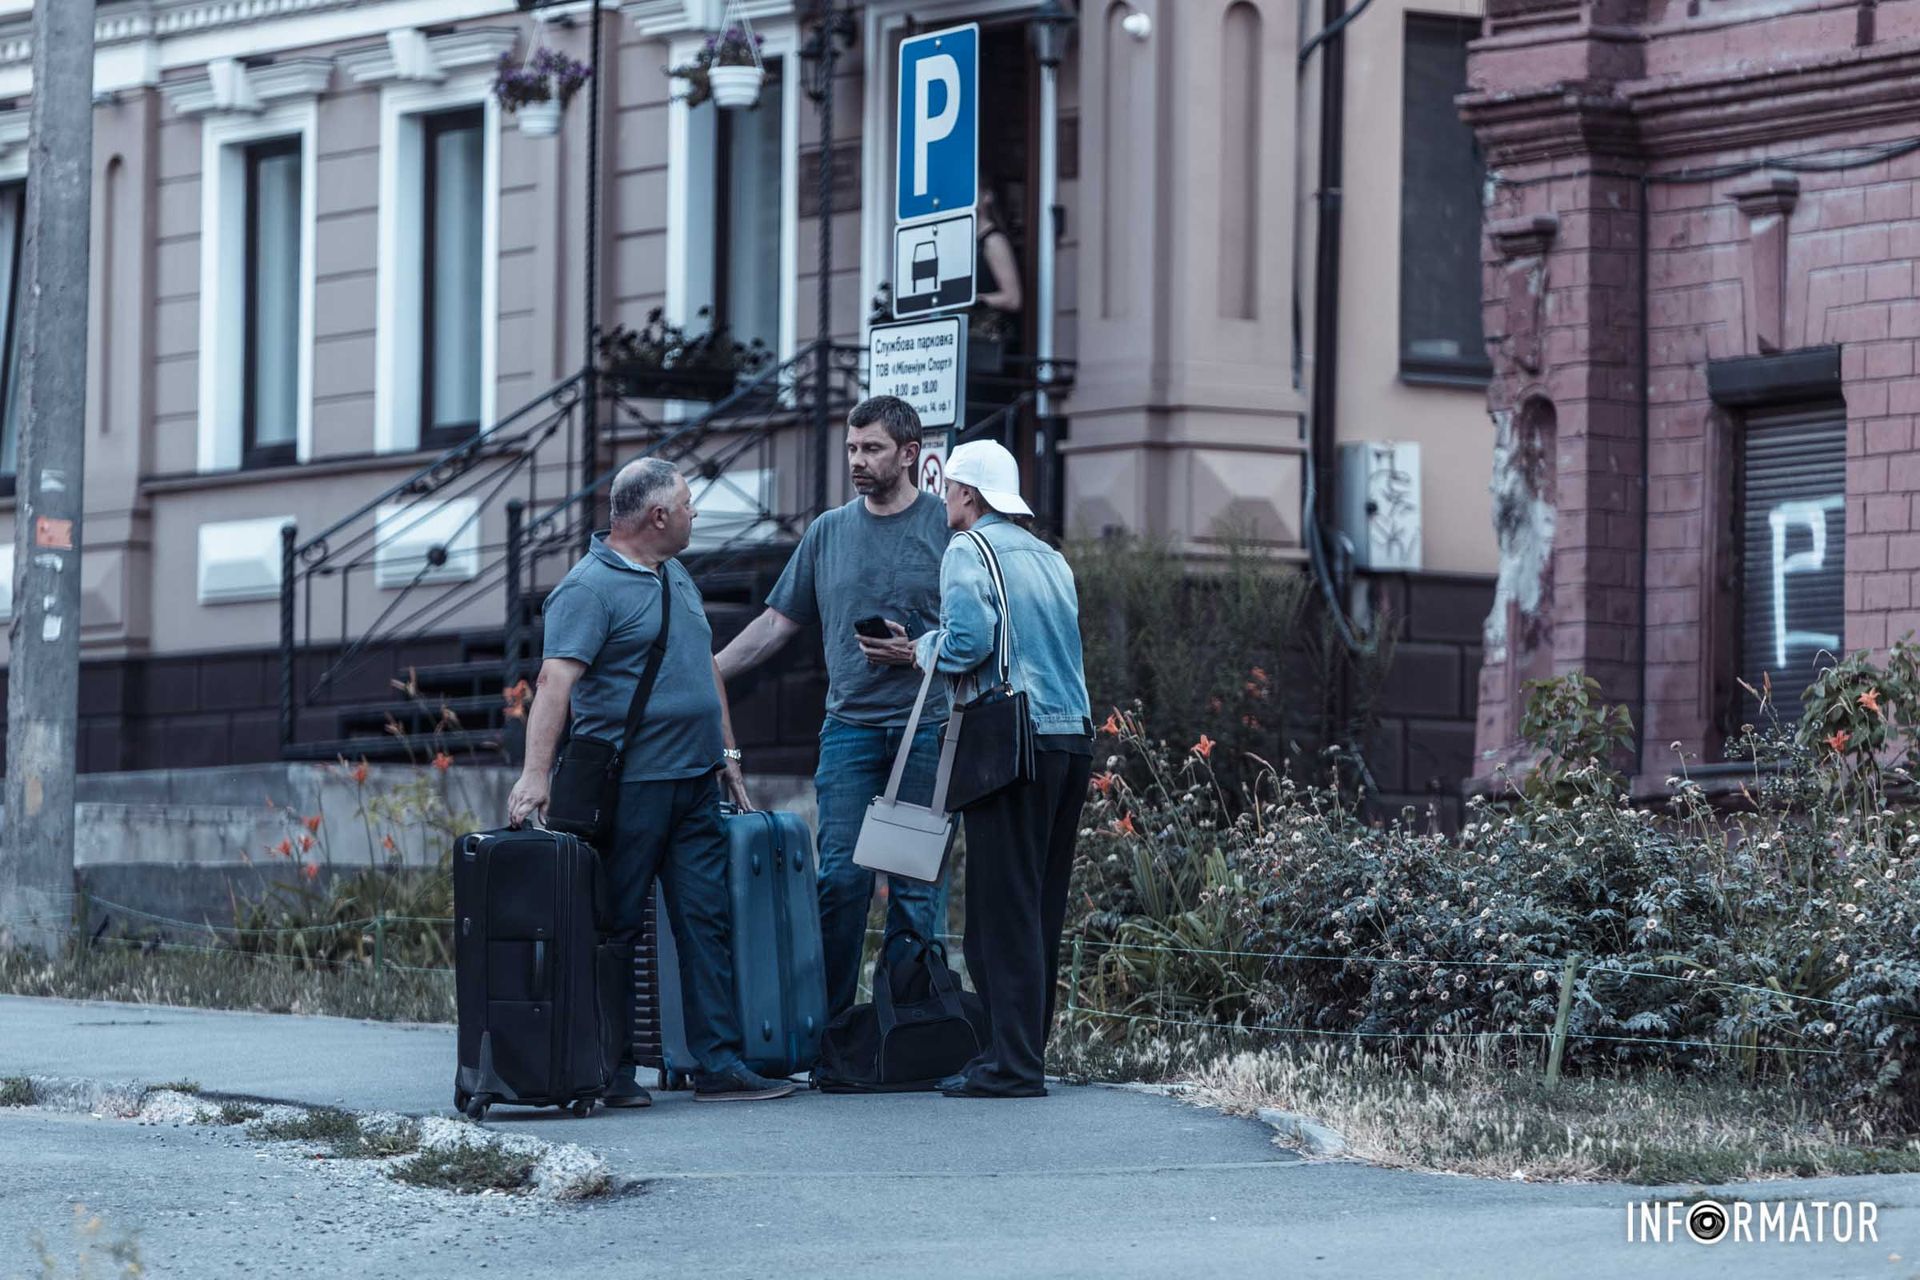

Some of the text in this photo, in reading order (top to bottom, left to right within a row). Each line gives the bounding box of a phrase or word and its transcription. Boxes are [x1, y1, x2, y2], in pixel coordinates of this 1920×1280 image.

[913, 53, 961, 197] P
[875, 333, 953, 357] Службова парковка
[876, 363, 889, 377] ТОВ
[911, 385, 919, 396] до
